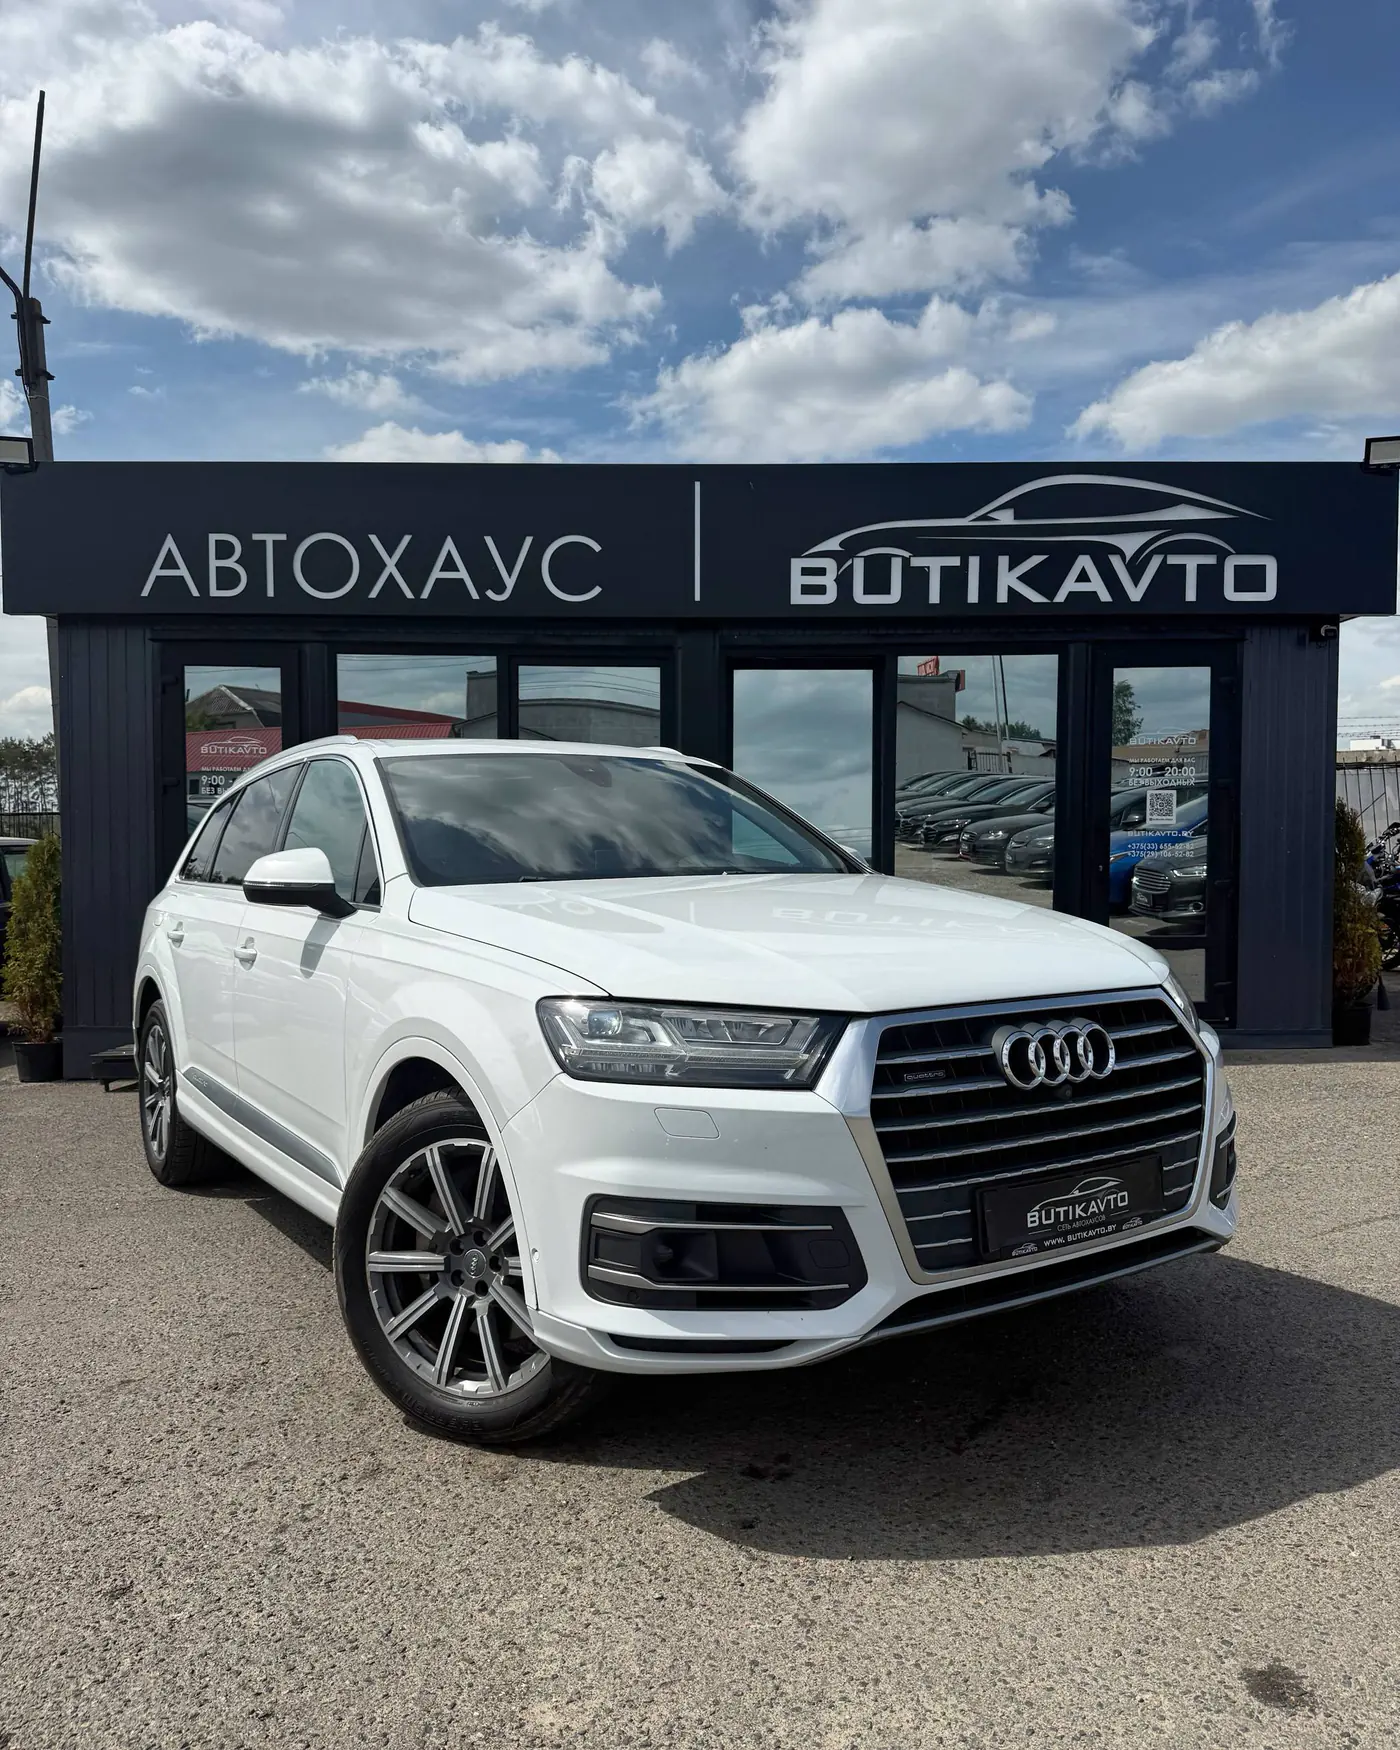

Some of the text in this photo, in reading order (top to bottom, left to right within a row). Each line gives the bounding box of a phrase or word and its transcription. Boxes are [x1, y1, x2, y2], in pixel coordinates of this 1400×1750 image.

[140, 531, 603, 603] АВТОХАУС
[789, 553, 1278, 605] BUTIKAVTO
[1129, 737, 1196, 745] BUTIKAVTO
[200, 746, 267, 754] BUTIKAVTO
[1129, 767, 1153, 777] 9:00
[1164, 766, 1196, 776] 20:00
[201, 775, 225, 785] 9:00
[1145, 778, 1195, 787] ВЫХОДНЫХ
[201, 786, 215, 795] БЕЗ
[1026, 1191, 1129, 1228] BUTIKAVTO
[1056, 1214, 1107, 1232] СЕТЬ АВТОХАУСОВ
